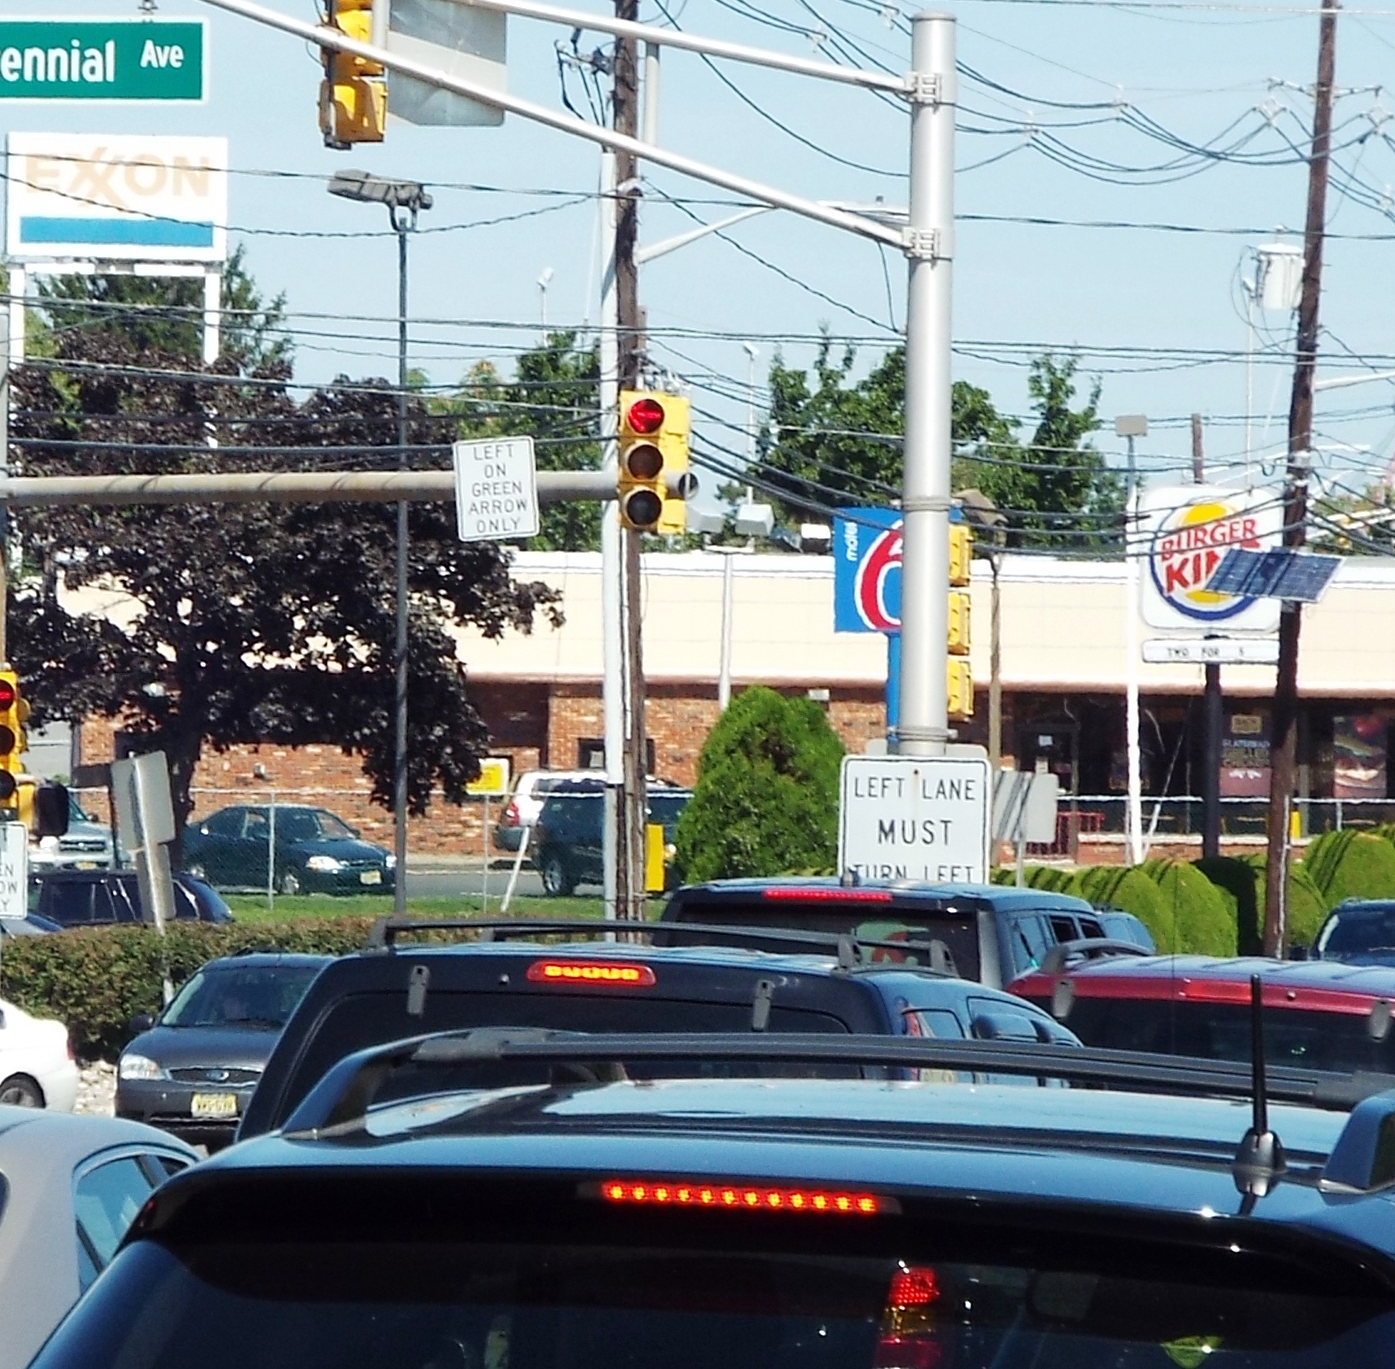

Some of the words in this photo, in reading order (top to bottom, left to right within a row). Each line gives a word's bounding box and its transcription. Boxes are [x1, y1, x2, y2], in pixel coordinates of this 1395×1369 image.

[140, 40, 184, 68] Ave
[24, 147, 212, 209] EXXON
[473, 444, 513, 460] LEFT
[484, 463, 506, 478] ON
[471, 481, 522, 497] GREEN
[468, 500, 527, 515] ARROW
[476, 517, 520, 534] ONLY
[844, 521, 858, 561] motel
[1161, 518, 1257, 562] BURGER
[1167, 648, 1189, 657] TWO
[1201, 648, 1220, 657] FOR
[854, 777, 905, 798] LEFT
[922, 778, 976, 801] LANE
[877, 819, 952, 845] MUST
